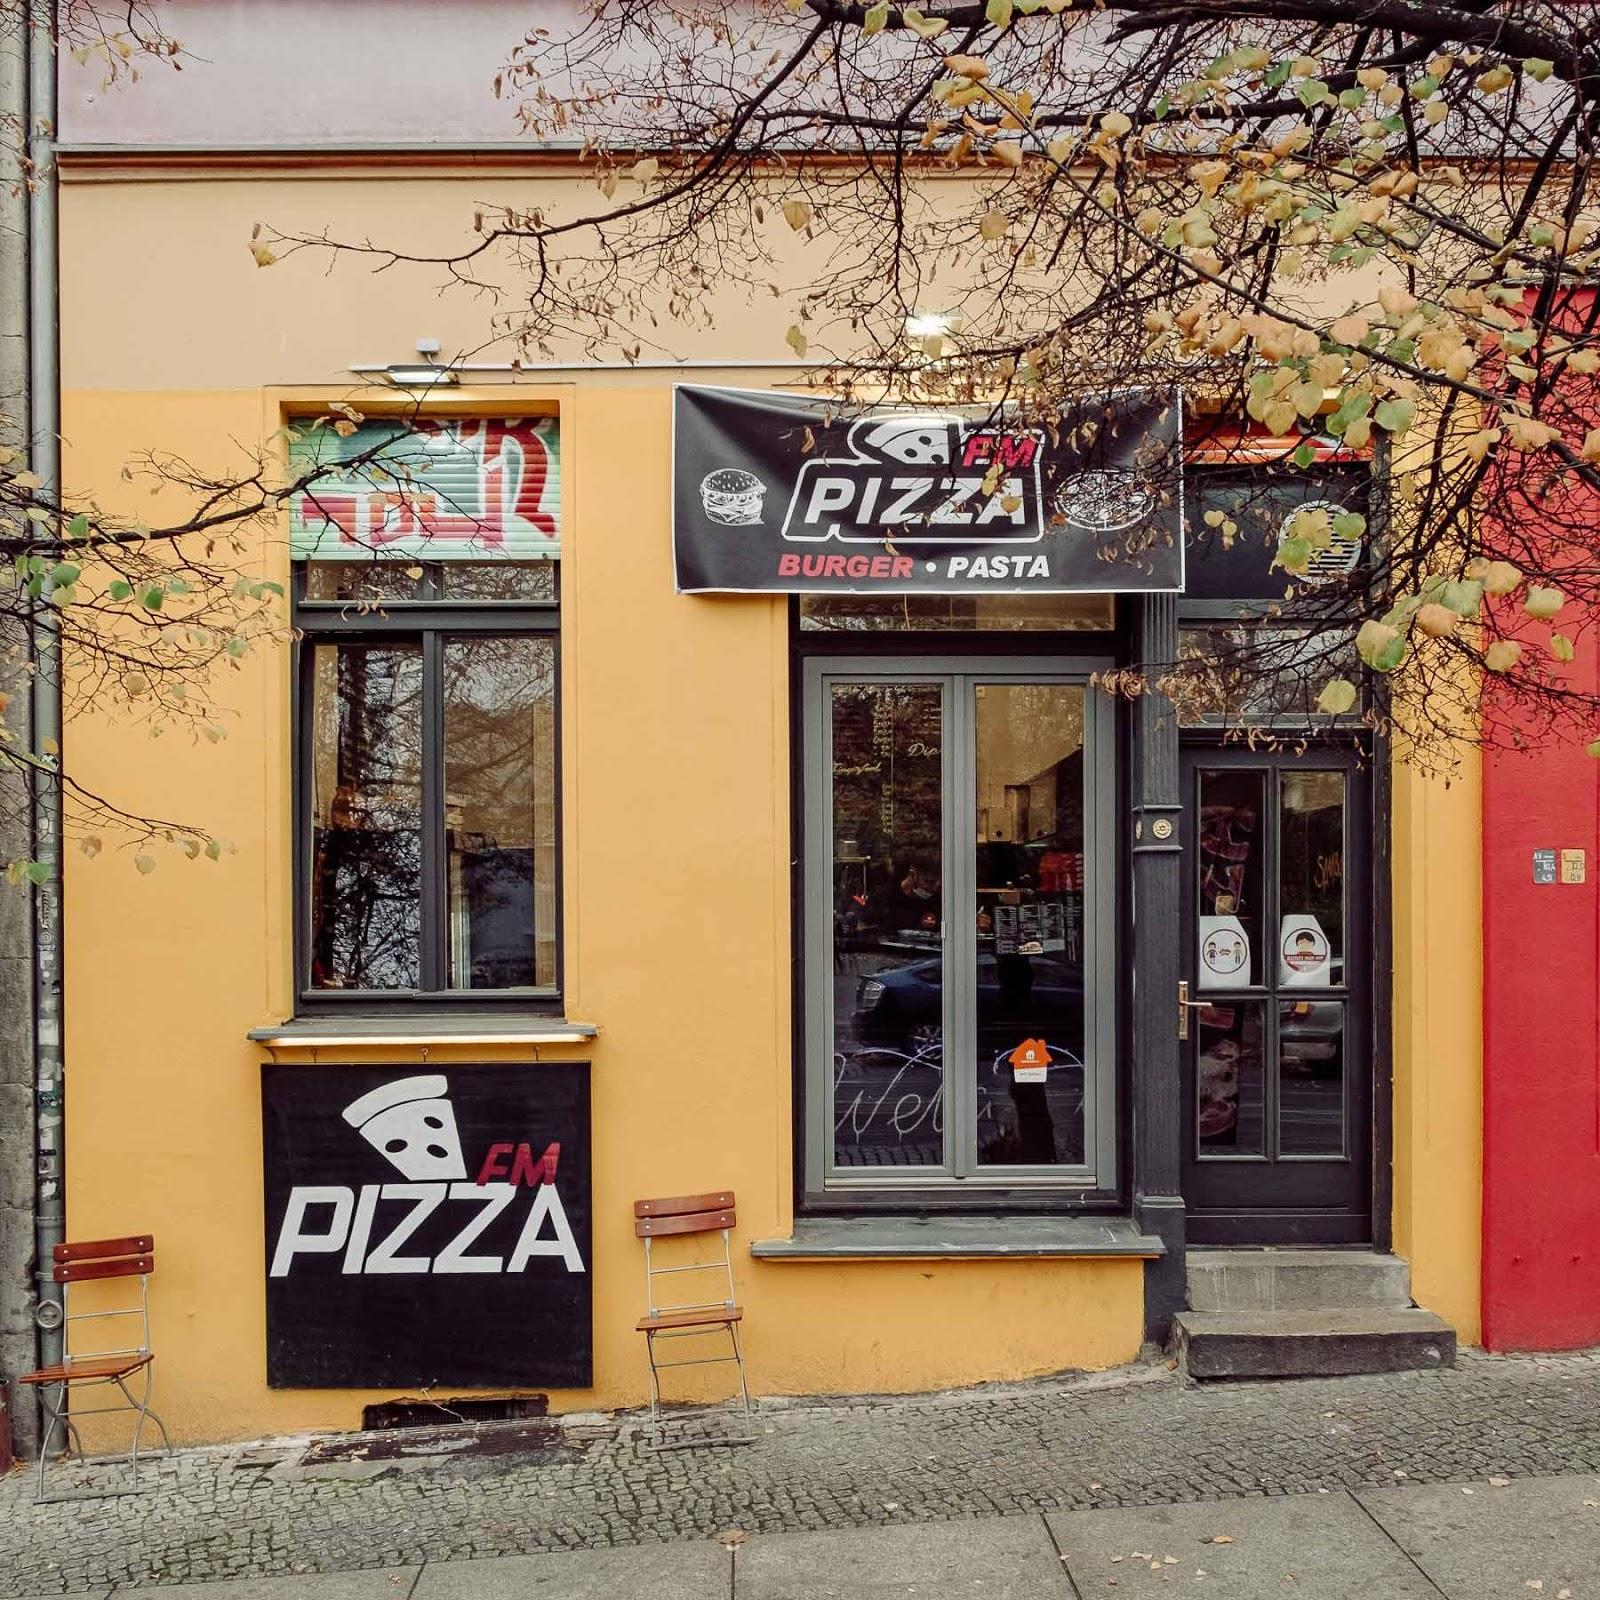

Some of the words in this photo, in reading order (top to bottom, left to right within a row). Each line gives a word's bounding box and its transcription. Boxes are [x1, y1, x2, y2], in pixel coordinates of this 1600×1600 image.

[962, 434, 1039, 468] FM
[803, 477, 1026, 526] PIZZA
[778, 555, 914, 579] BURGER
[947, 555, 1050, 579] PASTA
[476, 1141, 562, 1187] FM
[269, 1183, 586, 1278] PIZZA
